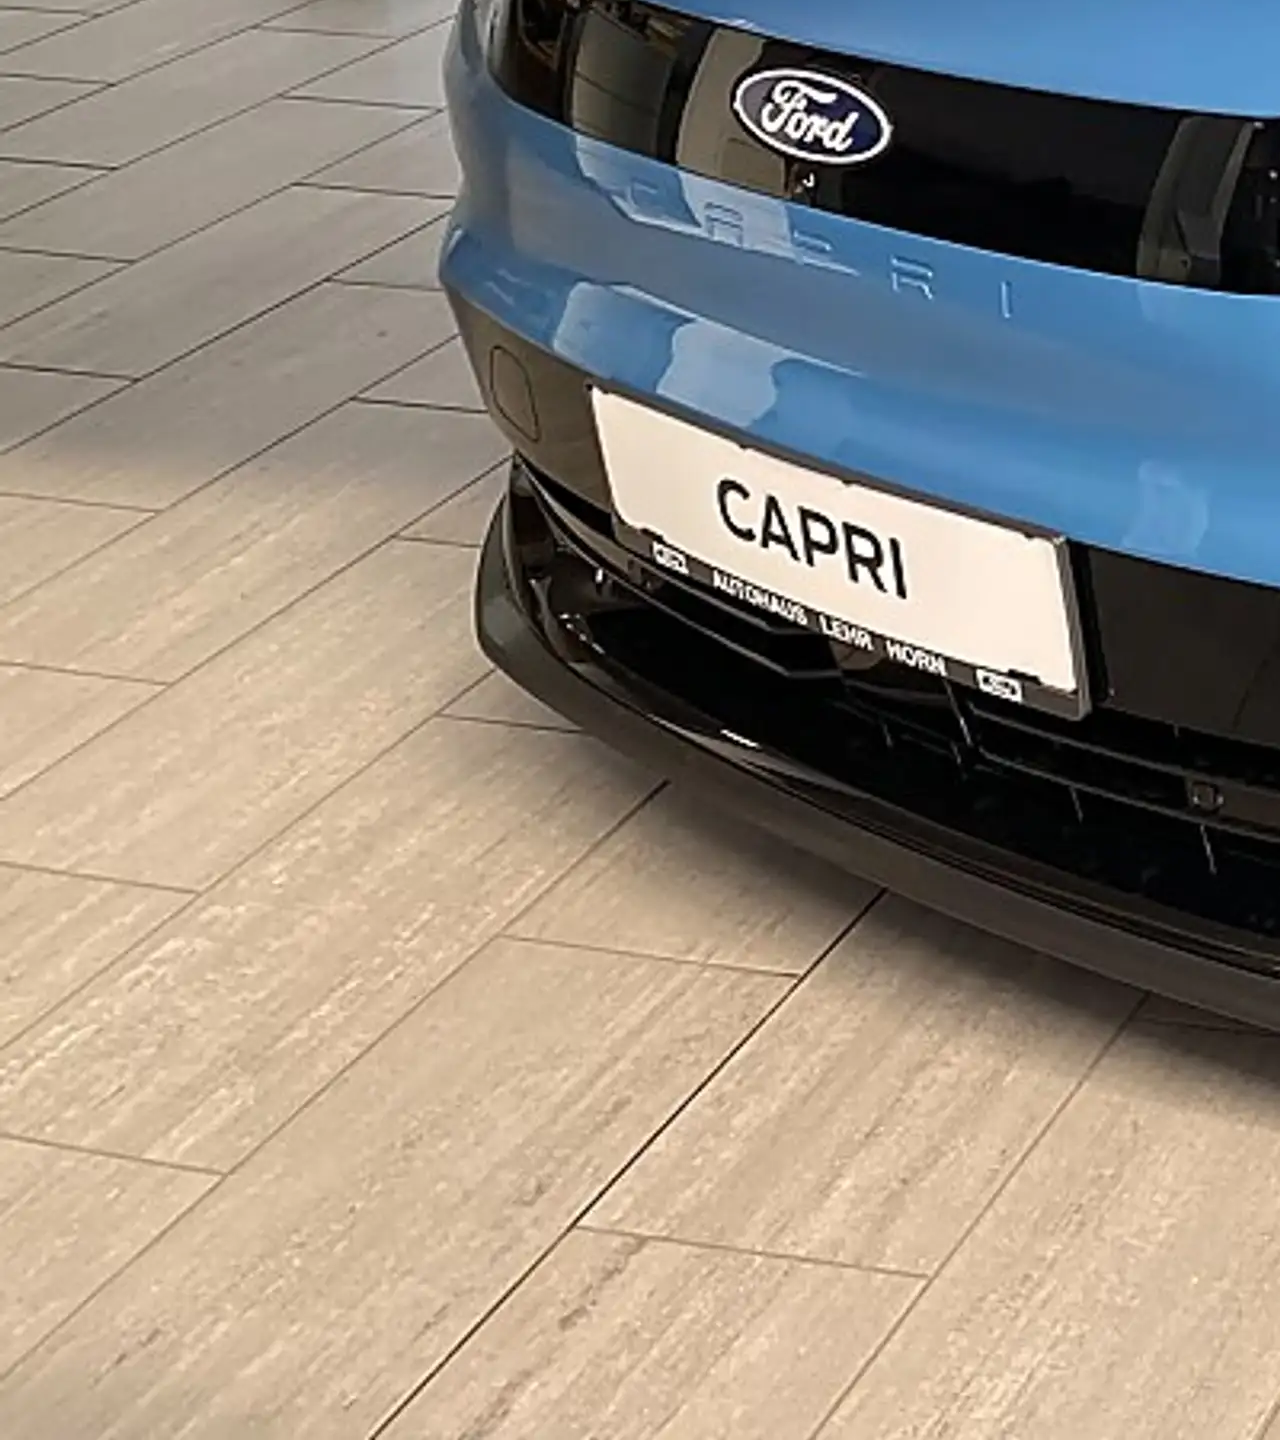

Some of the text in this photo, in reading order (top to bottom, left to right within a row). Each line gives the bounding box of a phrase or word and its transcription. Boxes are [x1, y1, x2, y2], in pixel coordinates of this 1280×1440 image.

[760, 79, 860, 153] Ford
[716, 478, 908, 600] CAPRI
[712, 569, 947, 676] AUTOHAUS LEHR HORN
